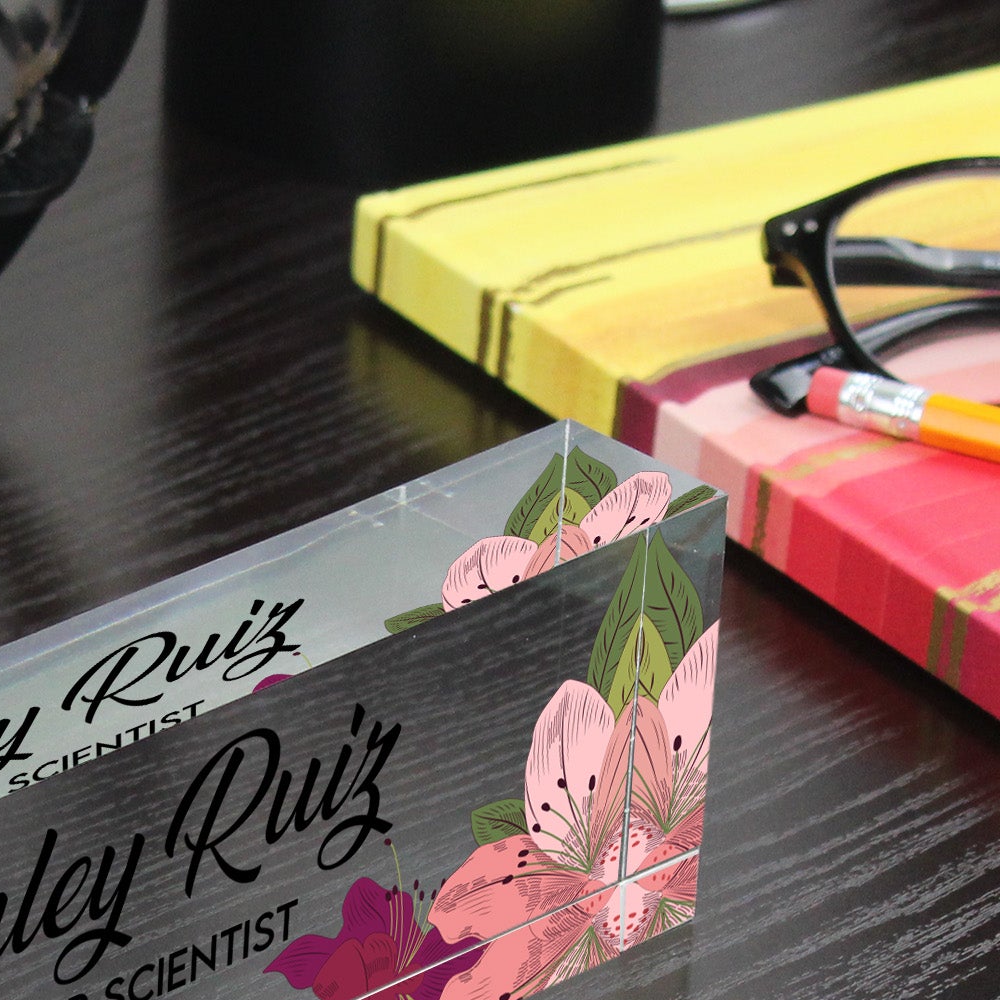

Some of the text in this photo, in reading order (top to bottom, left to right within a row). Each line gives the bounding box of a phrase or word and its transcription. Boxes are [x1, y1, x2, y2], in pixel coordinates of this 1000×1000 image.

[61, 598, 304, 725] Ruiz
[8, 700, 205, 794] SCIENTIST
[165, 703, 402, 899] Ruiz
